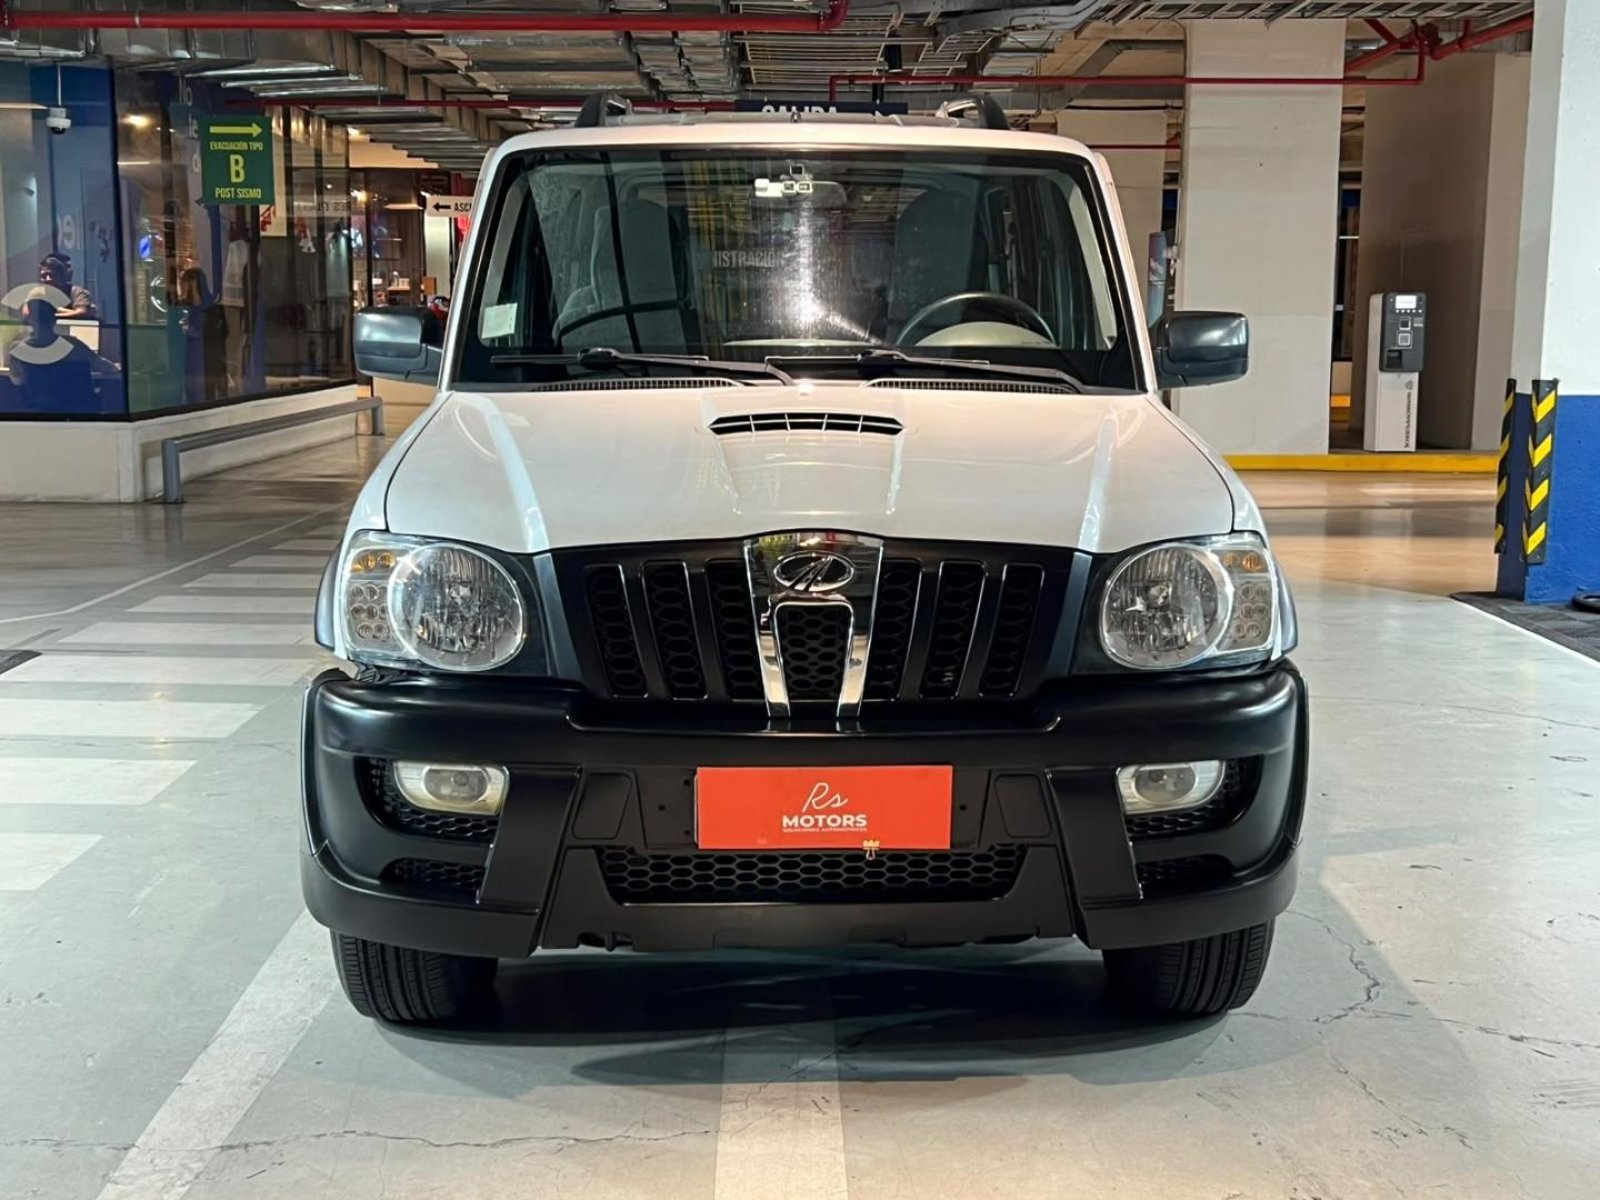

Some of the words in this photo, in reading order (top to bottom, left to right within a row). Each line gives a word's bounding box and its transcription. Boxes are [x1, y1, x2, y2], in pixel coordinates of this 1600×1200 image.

[249, 141, 264, 151] TIPO
[230, 154, 246, 183] B
[215, 188, 235, 199] POST
[236, 188, 262, 199] SISMO
[454, 202, 472, 212] ASC
[801, 782, 849, 813] Rs
[782, 814, 868, 828] MOTORS
